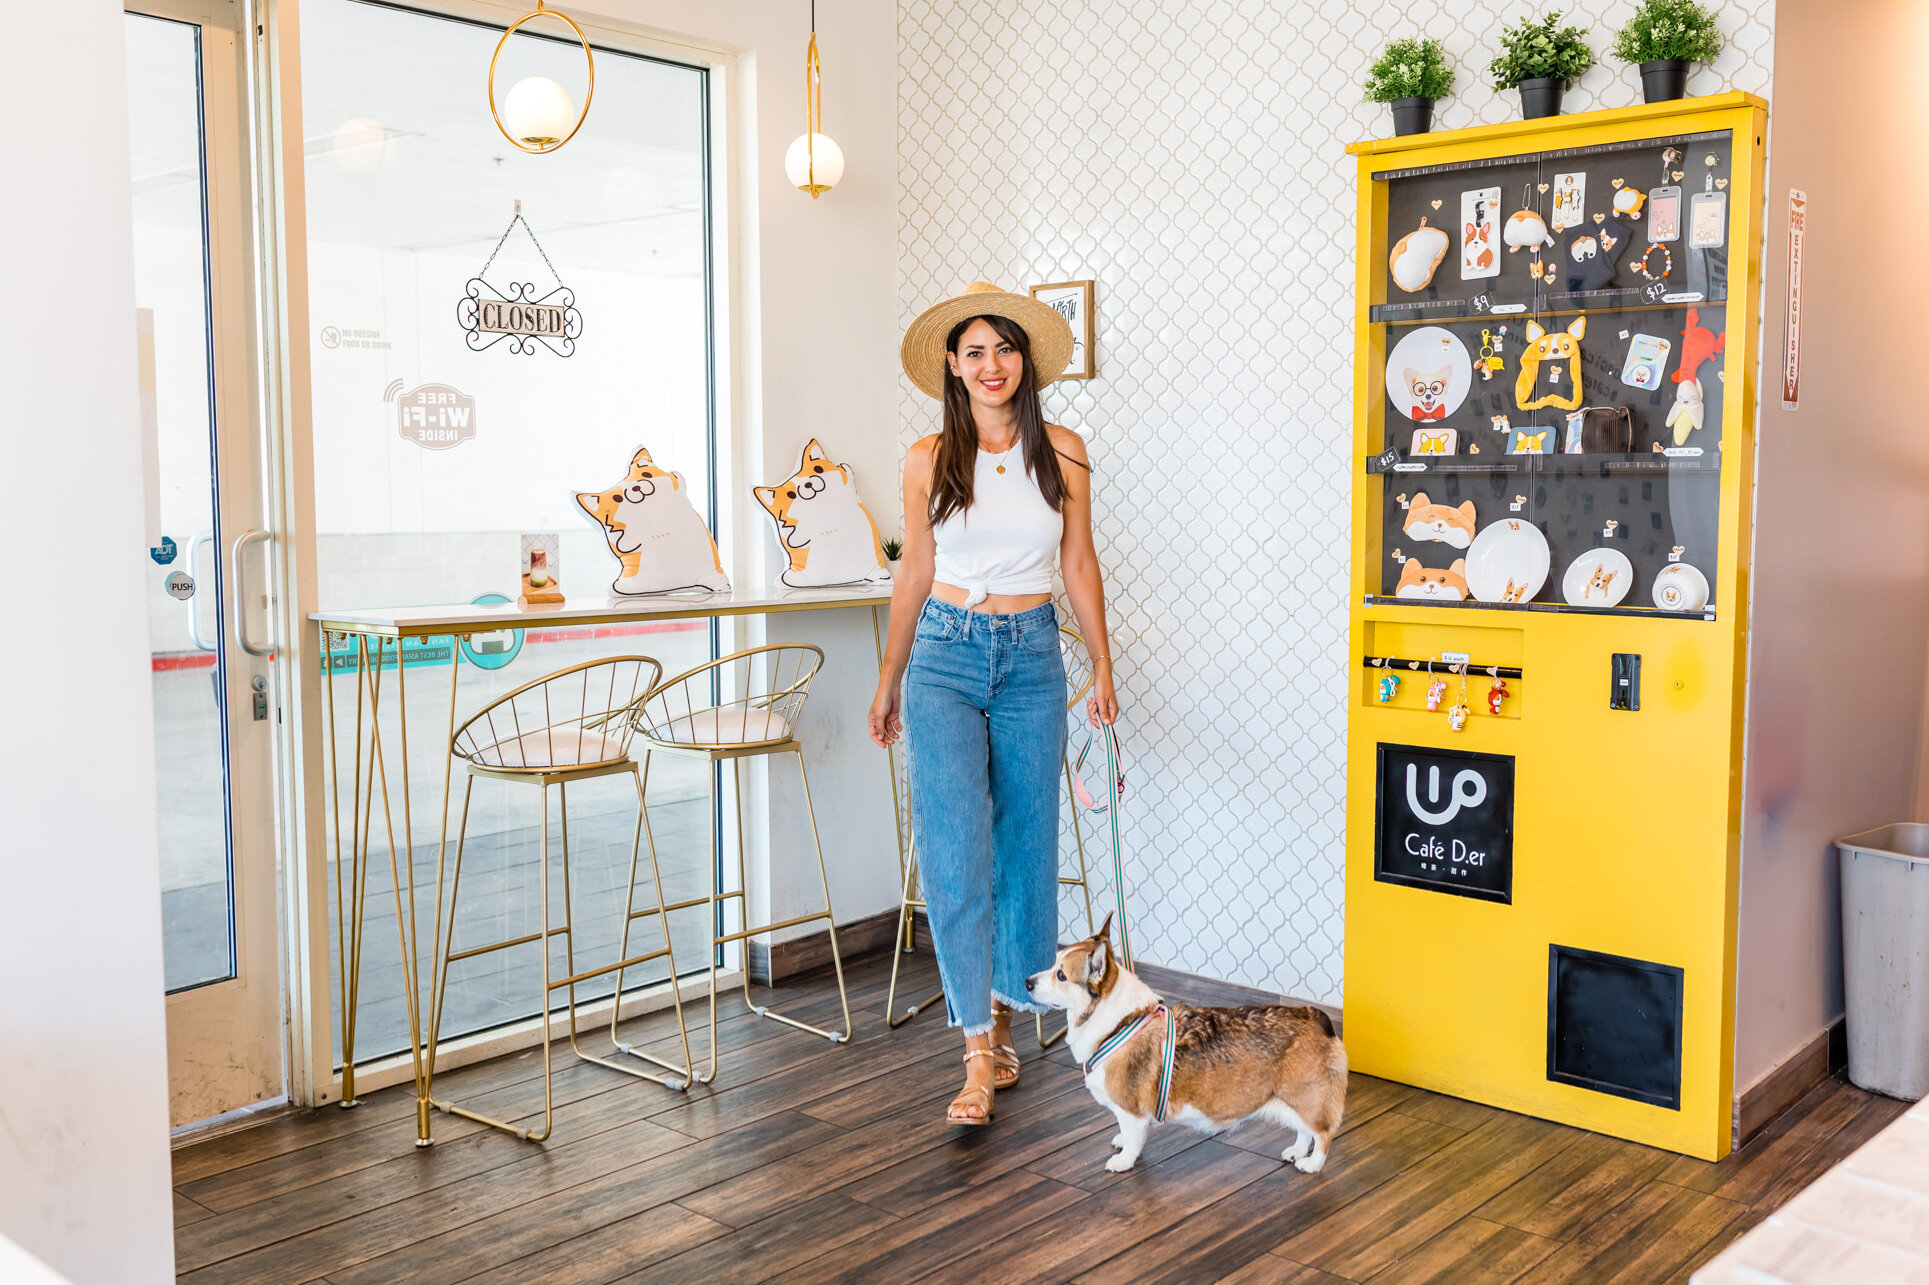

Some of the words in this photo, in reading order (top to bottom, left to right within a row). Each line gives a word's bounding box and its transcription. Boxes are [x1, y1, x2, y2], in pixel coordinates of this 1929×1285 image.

[1791, 210, 1804, 231] FIRE
[1646, 283, 1667, 300] $12
[1473, 295, 1490, 311] $9
[483, 303, 561, 333] CLOSED
[1788, 234, 1800, 390] EXTINGUISHER
[342, 329, 352, 337] NO
[353, 329, 381, 339] OUTSIDE
[342, 339, 360, 348] FOOD
[361, 340, 371, 349] OR
[372, 341, 392, 350] DRINK
[1381, 452, 1395, 466] $15
[155, 544, 174, 555] ADT
[172, 583, 193, 591] PUSH
[1405, 833, 1445, 860] Café
[1452, 839, 1486, 867] D.er
